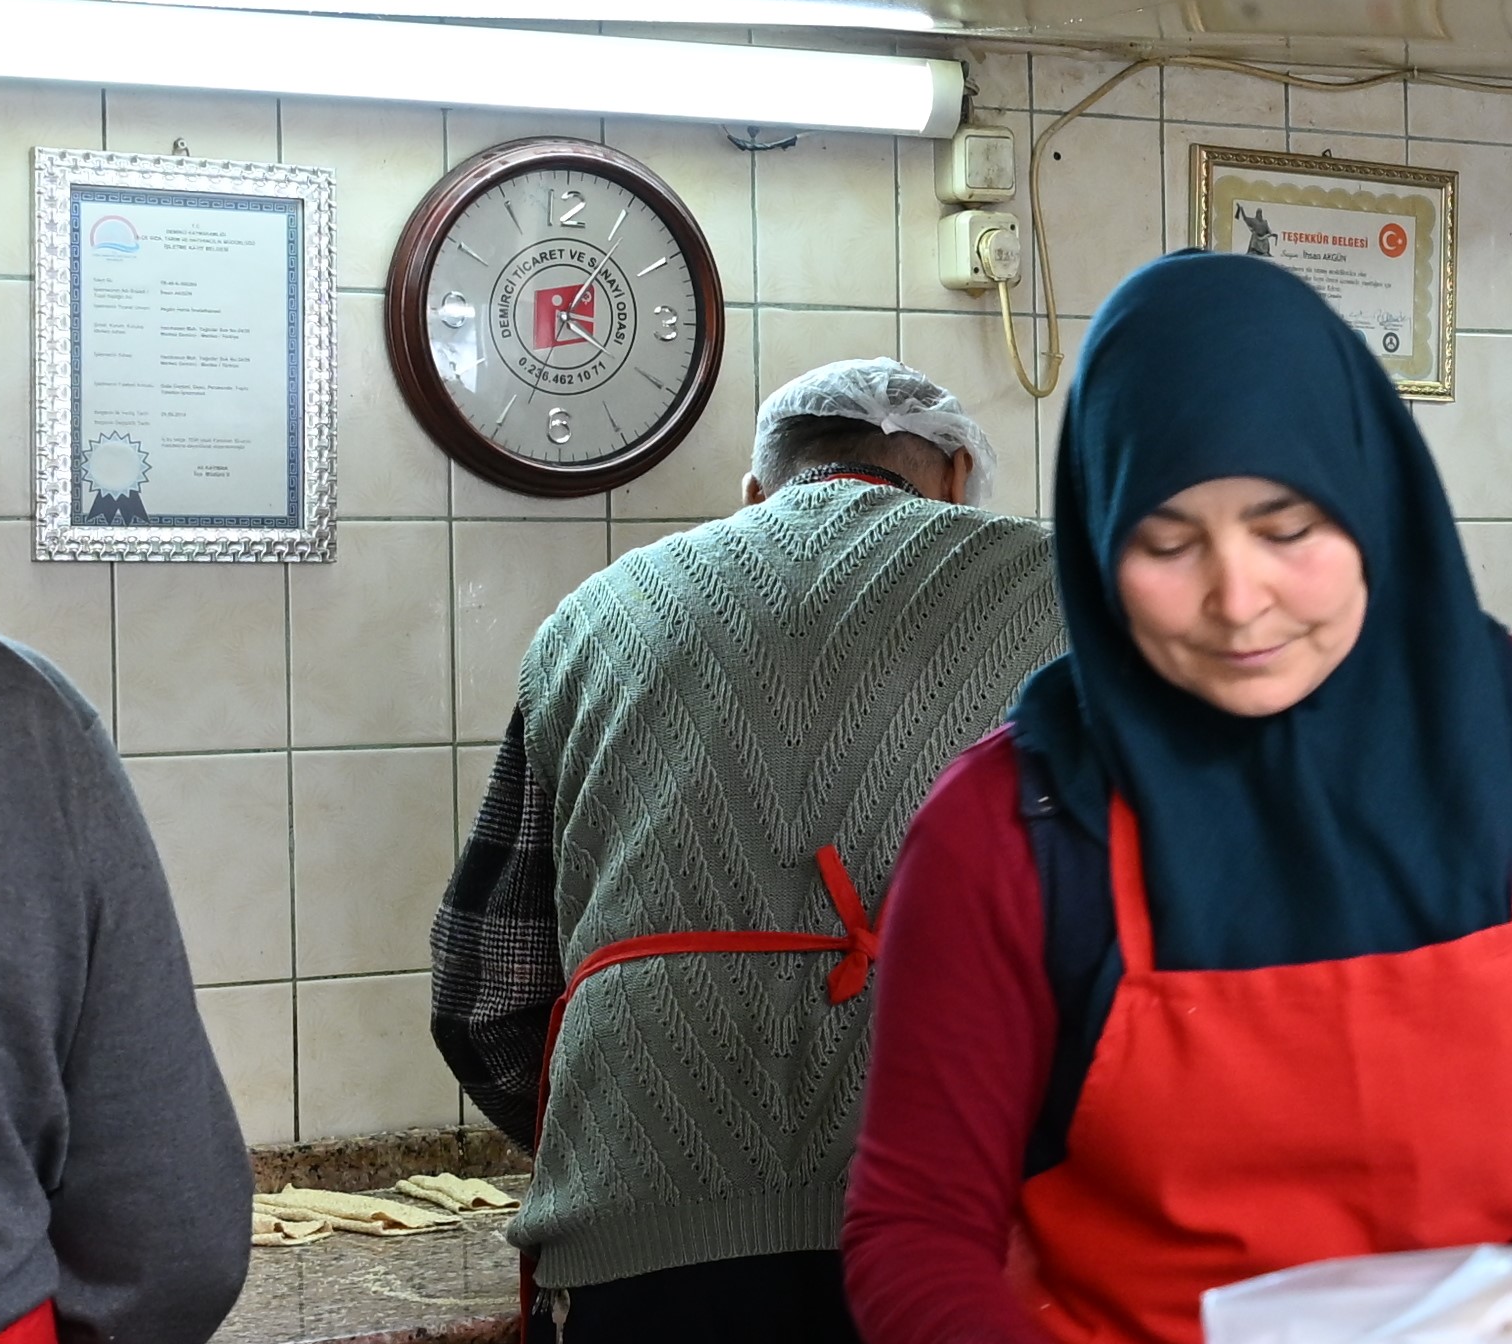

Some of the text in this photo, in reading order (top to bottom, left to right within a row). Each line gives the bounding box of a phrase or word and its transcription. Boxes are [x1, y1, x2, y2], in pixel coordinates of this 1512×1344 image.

[546, 189, 586, 227] 12
[1281, 231, 1368, 249] TEŞEKKÜR BELGESİ
[500, 248, 628, 345] DEMİRCİ TİCARET VE SANAYİ ODASI
[653, 305, 678, 342] 3
[577, 368, 592, 385] 10
[590, 359, 607, 376] 71
[546, 407, 572, 444] 6
